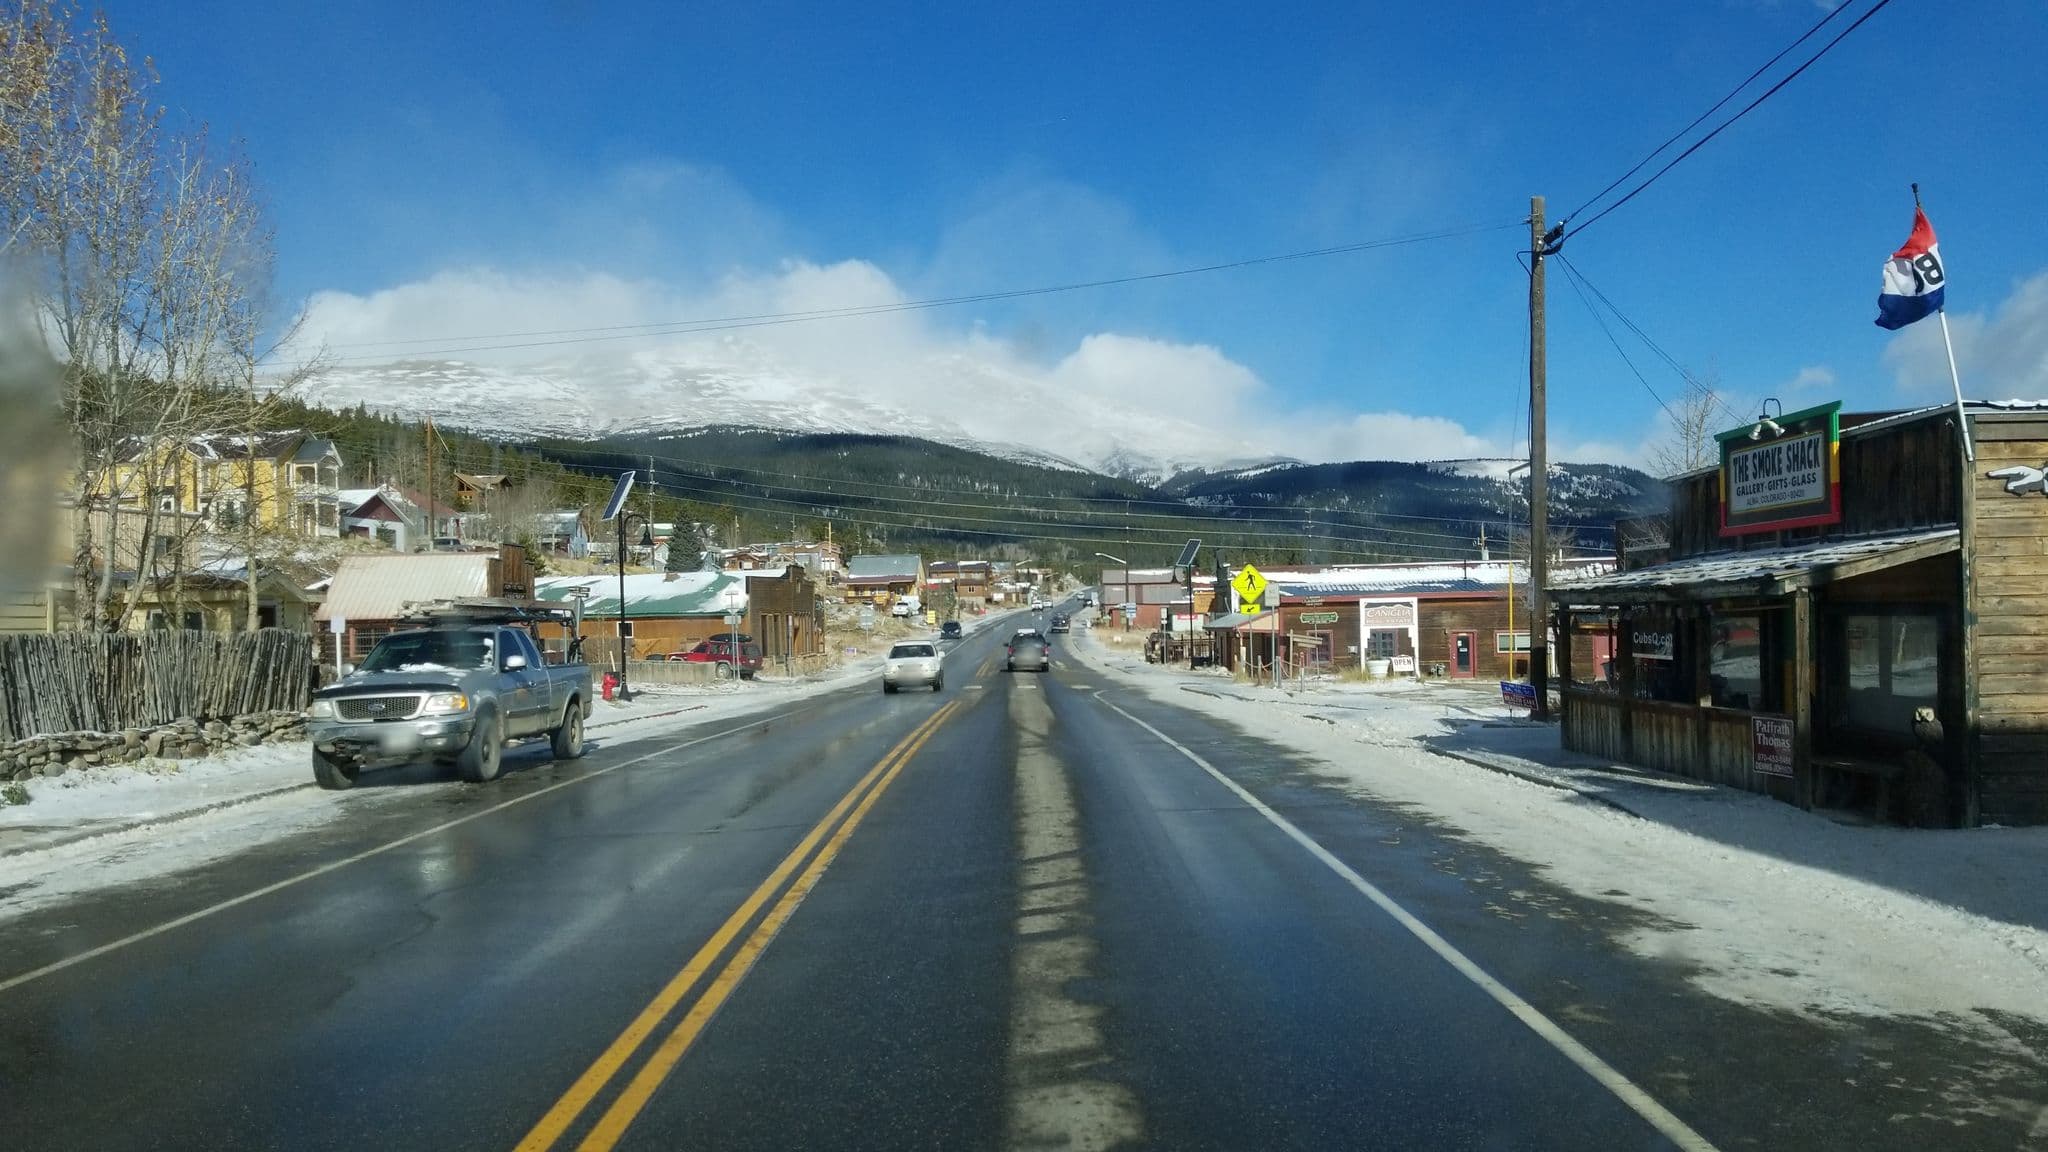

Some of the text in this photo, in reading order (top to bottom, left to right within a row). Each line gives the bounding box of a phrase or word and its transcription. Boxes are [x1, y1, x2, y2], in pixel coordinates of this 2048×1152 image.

[1733, 438, 1820, 484] THE SMOKE SHACK
[1736, 482, 1765, 497] GALLERY
[1791, 472, 1817, 487] GLASS
[1366, 609, 1411, 618] CANIGLIA
[1394, 658, 1412, 666] OPEN
[1755, 720, 1790, 736] Paffrath
[1756, 732, 1791, 749] Thomas
